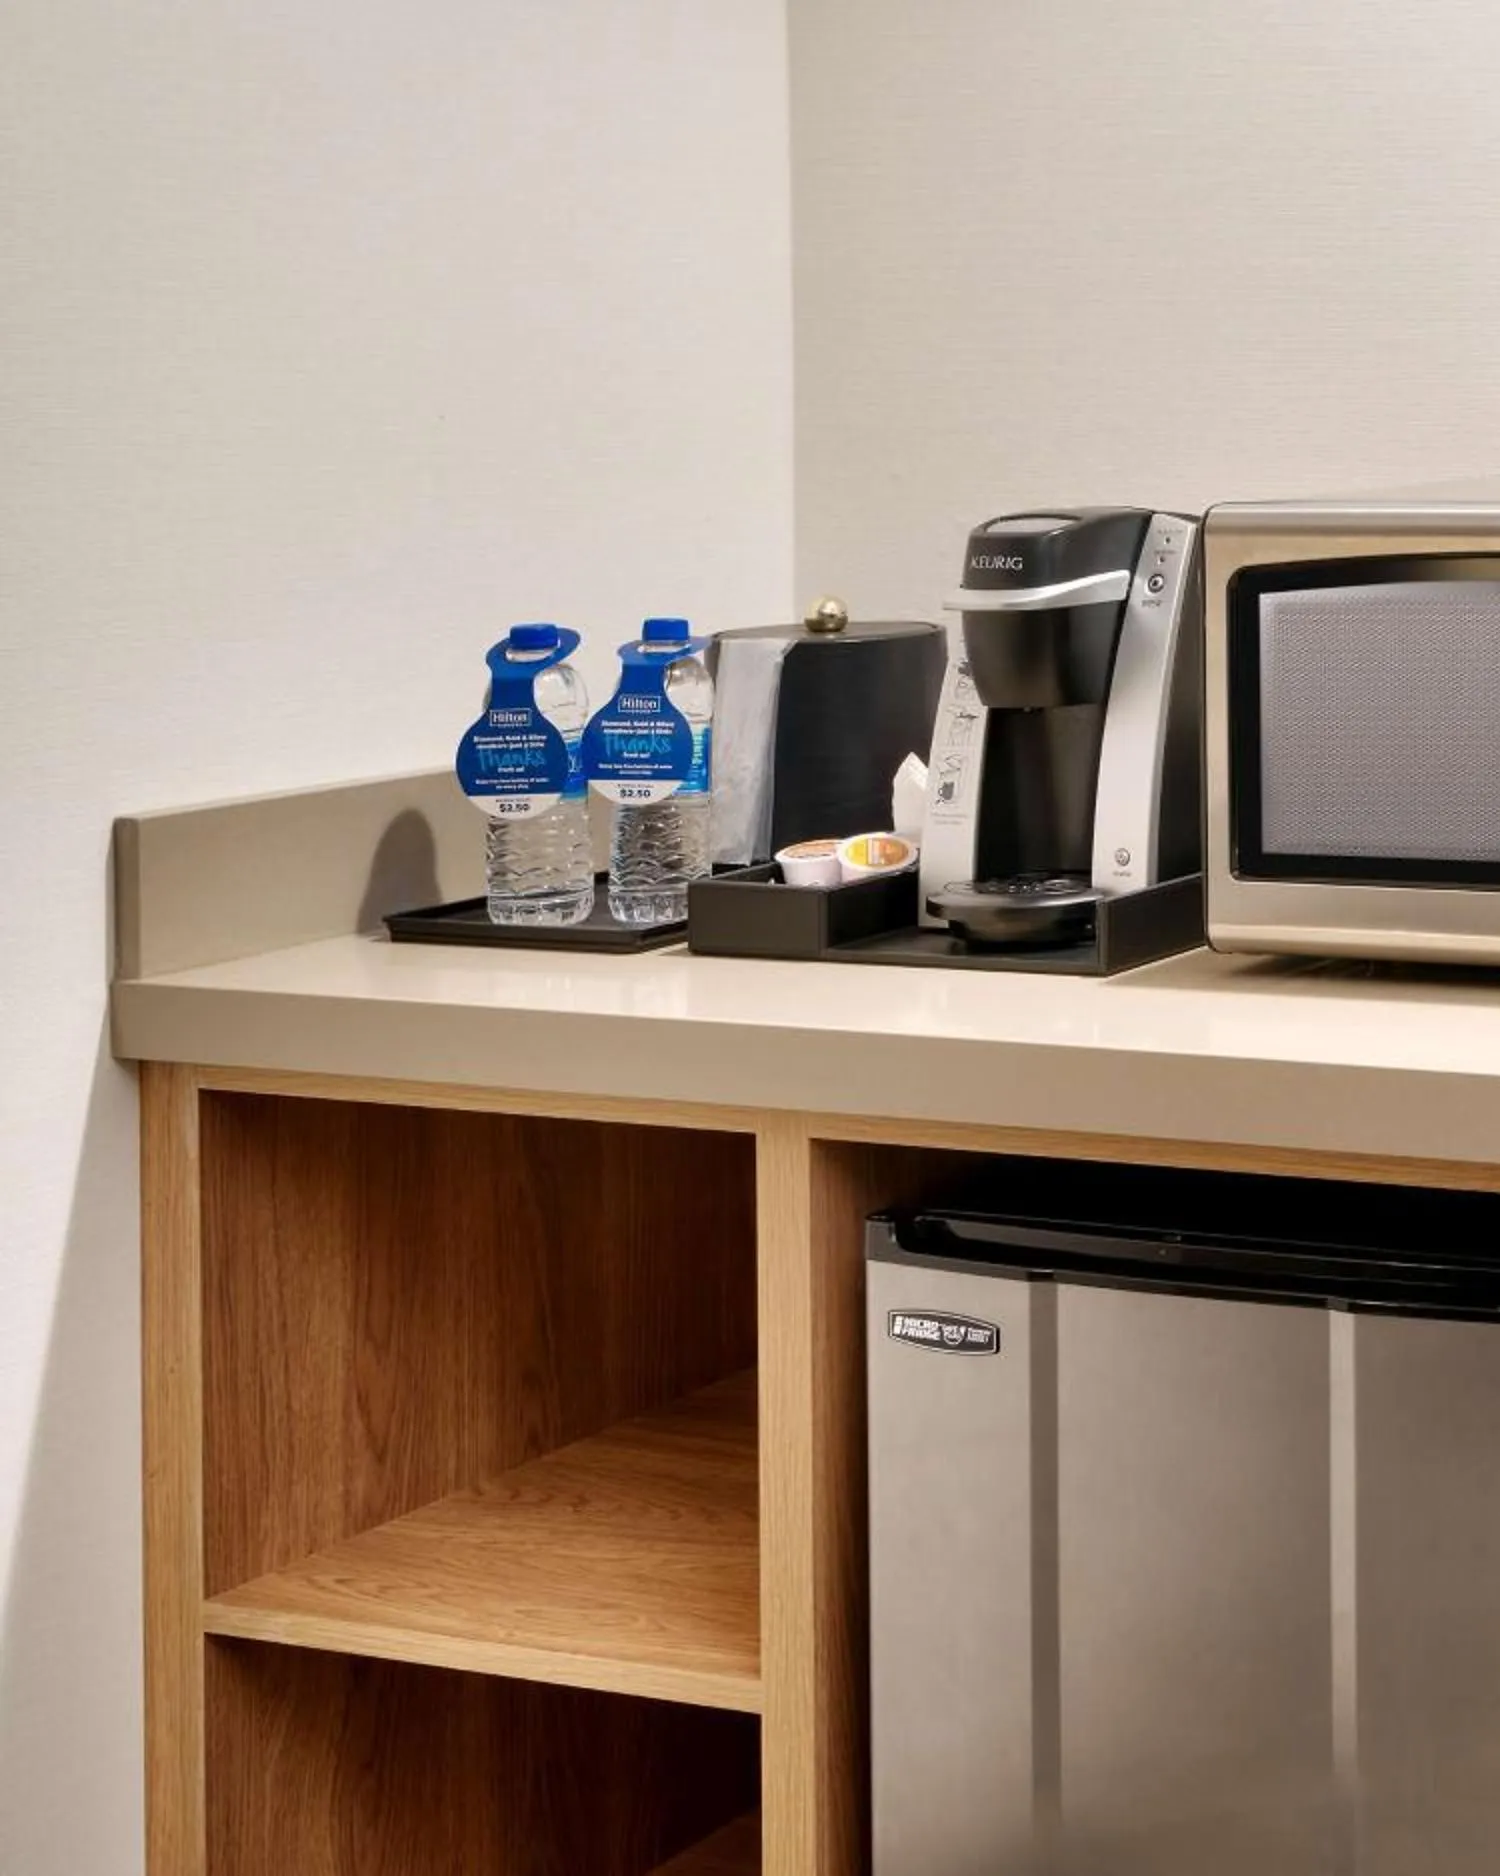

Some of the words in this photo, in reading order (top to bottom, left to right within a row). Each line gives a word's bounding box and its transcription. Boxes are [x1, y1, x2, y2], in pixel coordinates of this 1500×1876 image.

[971, 554, 1023, 571] KEURIG
[622, 696, 657, 709] Hilton
[493, 711, 527, 723] Hilton
[605, 734, 674, 757] Thanks
[478, 747, 547, 772] Thanks
[620, 789, 651, 798] $2.50
[499, 803, 530, 813] $2.50
[904, 1316, 939, 1329] MICRO
